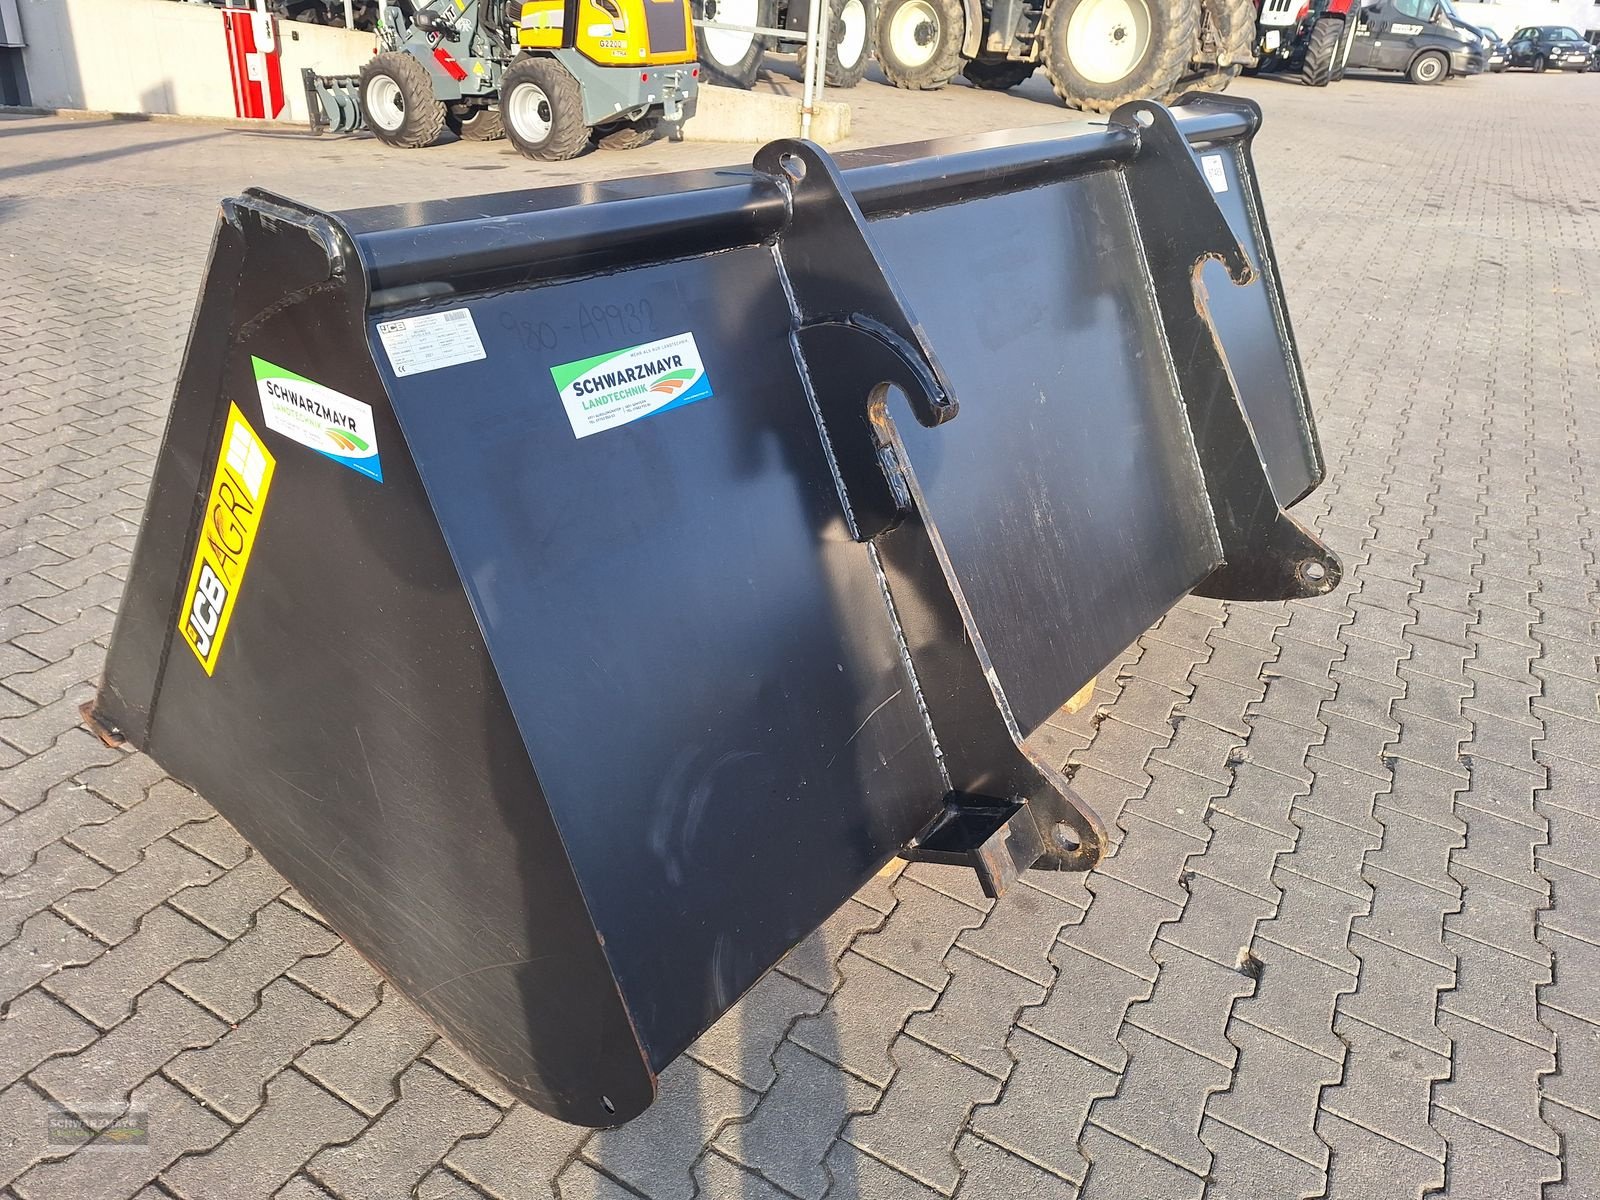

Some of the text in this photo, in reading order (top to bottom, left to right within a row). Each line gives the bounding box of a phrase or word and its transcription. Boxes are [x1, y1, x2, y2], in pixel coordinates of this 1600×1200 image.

[380, 321, 406, 334] JCB
[572, 354, 683, 397] SCHWARZMAYR
[581, 383, 648, 411] LANDTECHNIK
[266, 380, 357, 432] SCHWARZMAYR
[188, 467, 255, 658] JCB AGRI
